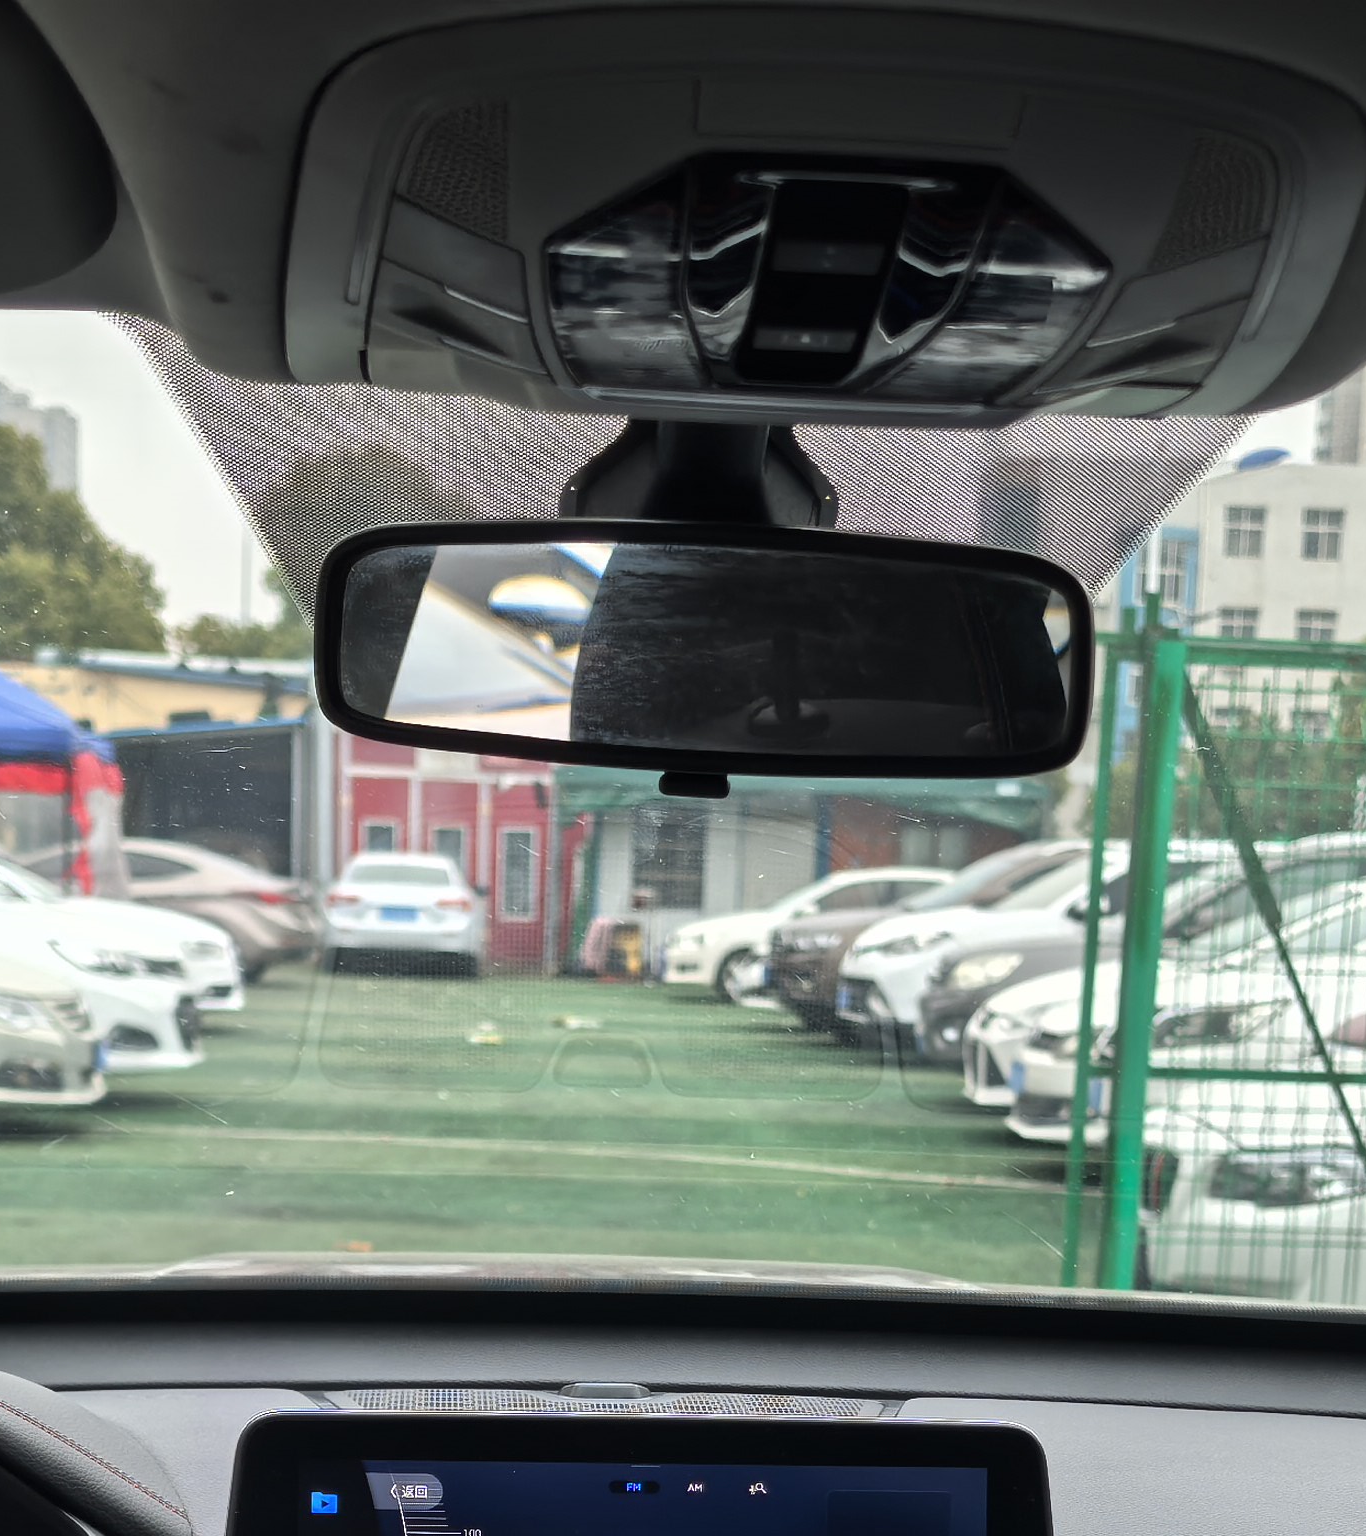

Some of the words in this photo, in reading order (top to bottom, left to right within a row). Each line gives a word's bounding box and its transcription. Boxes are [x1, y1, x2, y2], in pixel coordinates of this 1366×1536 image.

[401, 1485, 428, 1499] 返回
[627, 1483, 642, 1492] FM
[687, 1484, 703, 1492] AM
